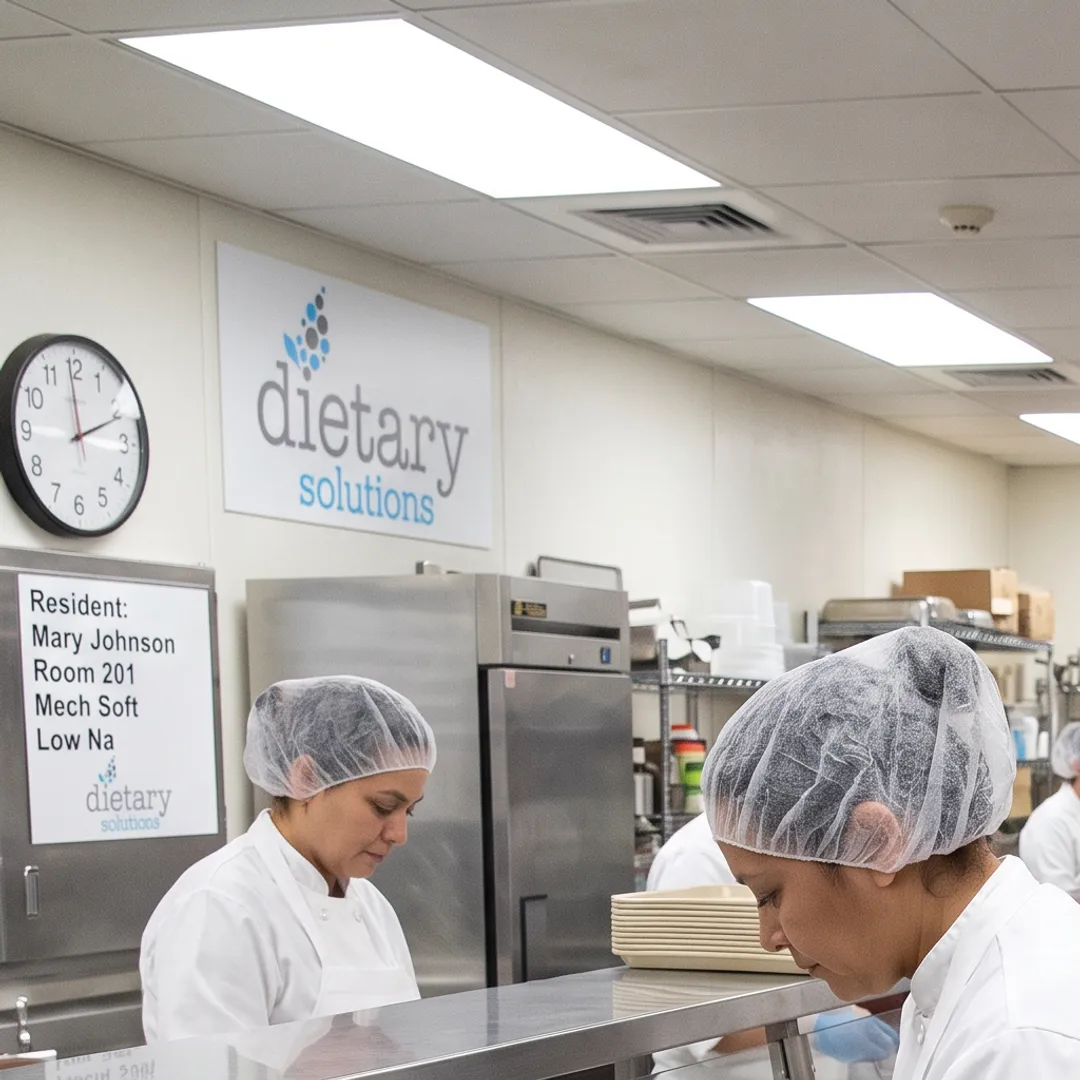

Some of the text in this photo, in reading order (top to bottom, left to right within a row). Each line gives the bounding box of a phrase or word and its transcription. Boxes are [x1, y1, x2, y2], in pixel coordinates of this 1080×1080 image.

[43, 364, 57, 386] 11
[66, 357, 83, 381] 12
[94, 372, 101, 393] 1
[24, 386, 44, 410] 10
[20, 419, 32, 441] 9
[257, 360, 469, 498] dietary
[118, 433, 129, 455] 3
[31, 455, 43, 477] 8
[113, 467, 124, 487] 4
[51, 482, 62, 503] 7
[97, 486, 108, 508] 5
[299, 465, 435, 526] solutions
[73, 495, 85, 516] 6
[30, 589, 128, 618] Resident:
[32, 624, 175, 655] Mary Johnson
[33, 658, 135, 685] Room 201
[35, 693, 139, 718] Mech Soft
[37, 728, 114, 751] Low Na
[86, 783, 172, 817] dietary
